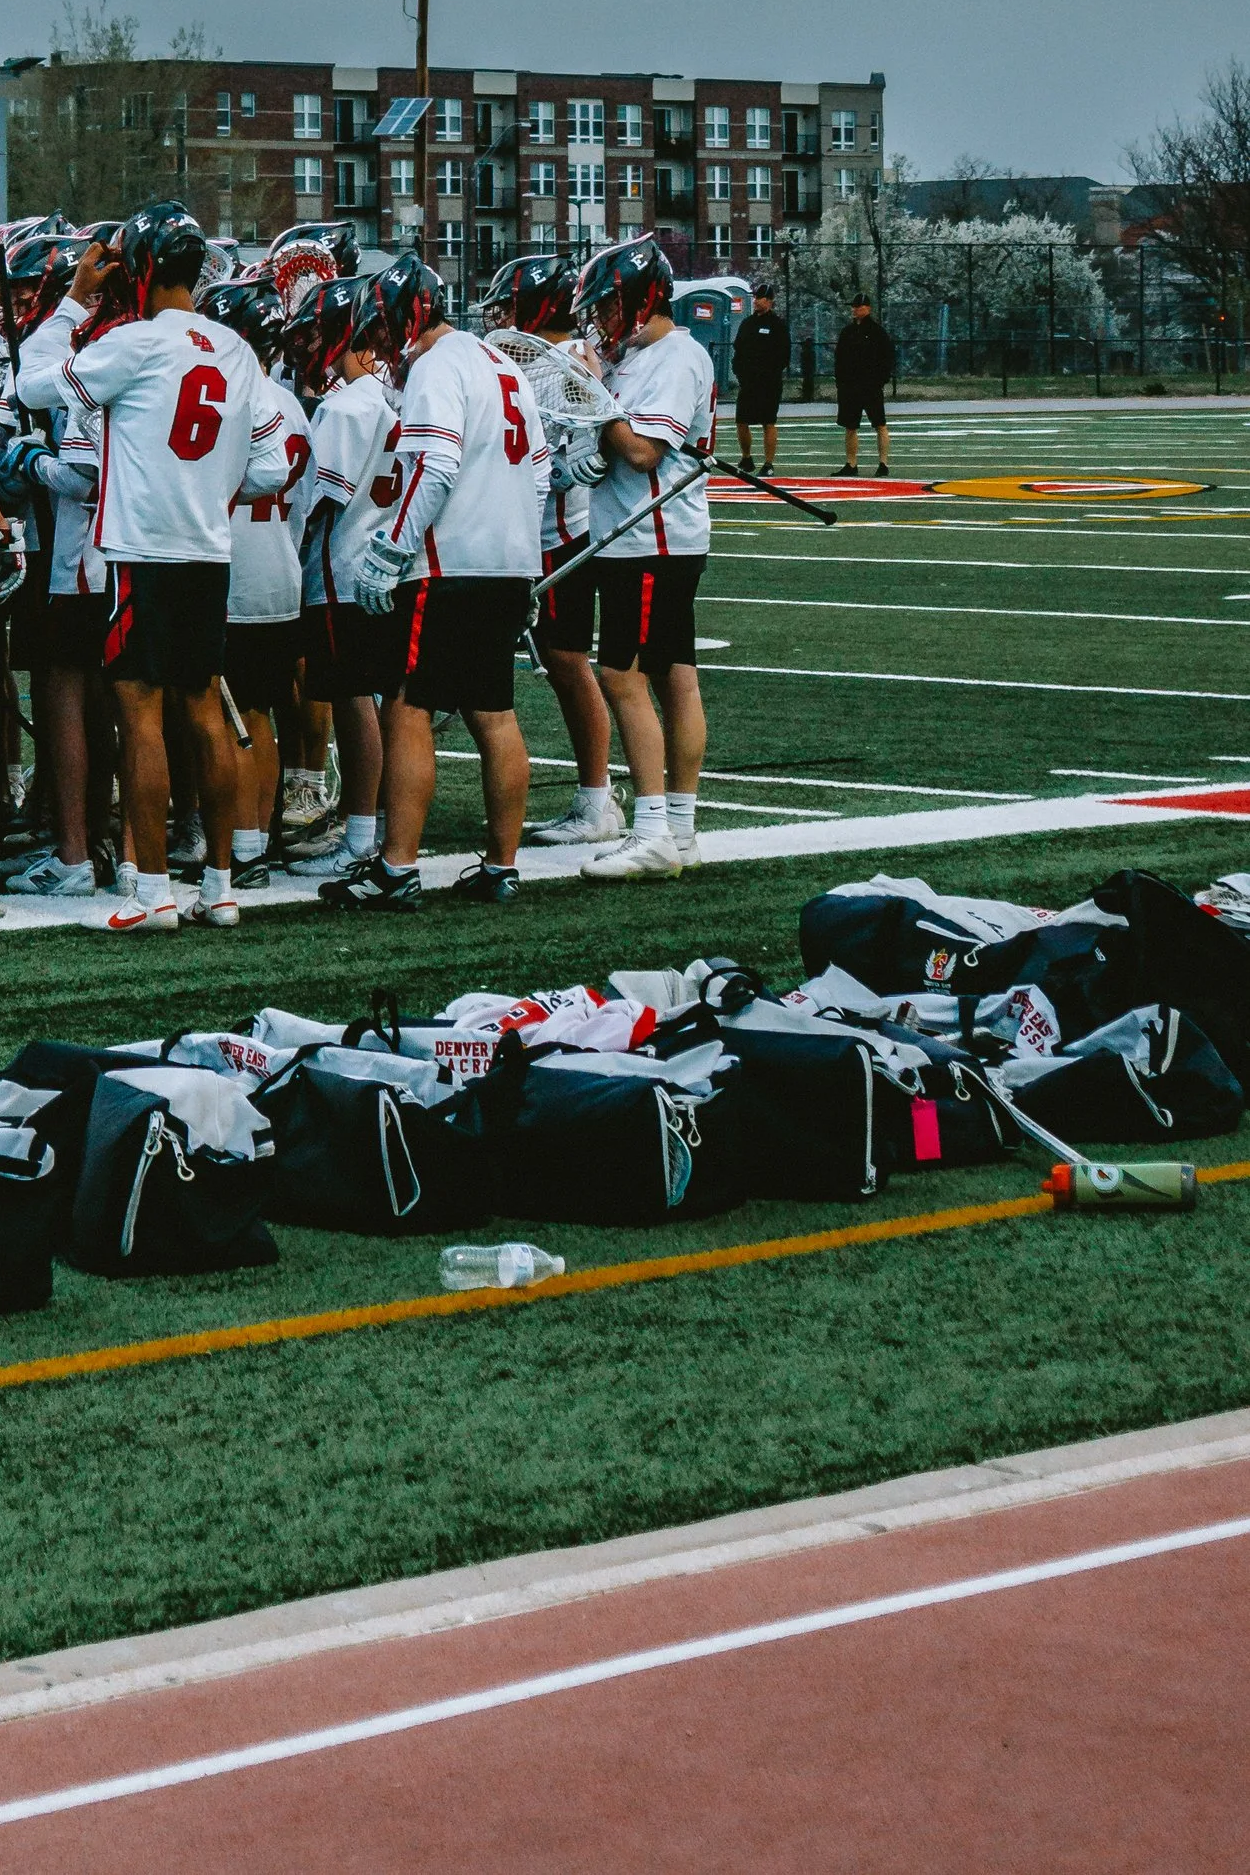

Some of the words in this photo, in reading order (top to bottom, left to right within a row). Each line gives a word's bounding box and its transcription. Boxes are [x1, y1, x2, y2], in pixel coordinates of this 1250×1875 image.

[168, 364, 227, 462] 6
[497, 374, 530, 465] 5
[1029, 1011, 1054, 1037] EAST
[246, 1048, 267, 1070] EAST
[435, 1041, 488, 1057] DENVER
